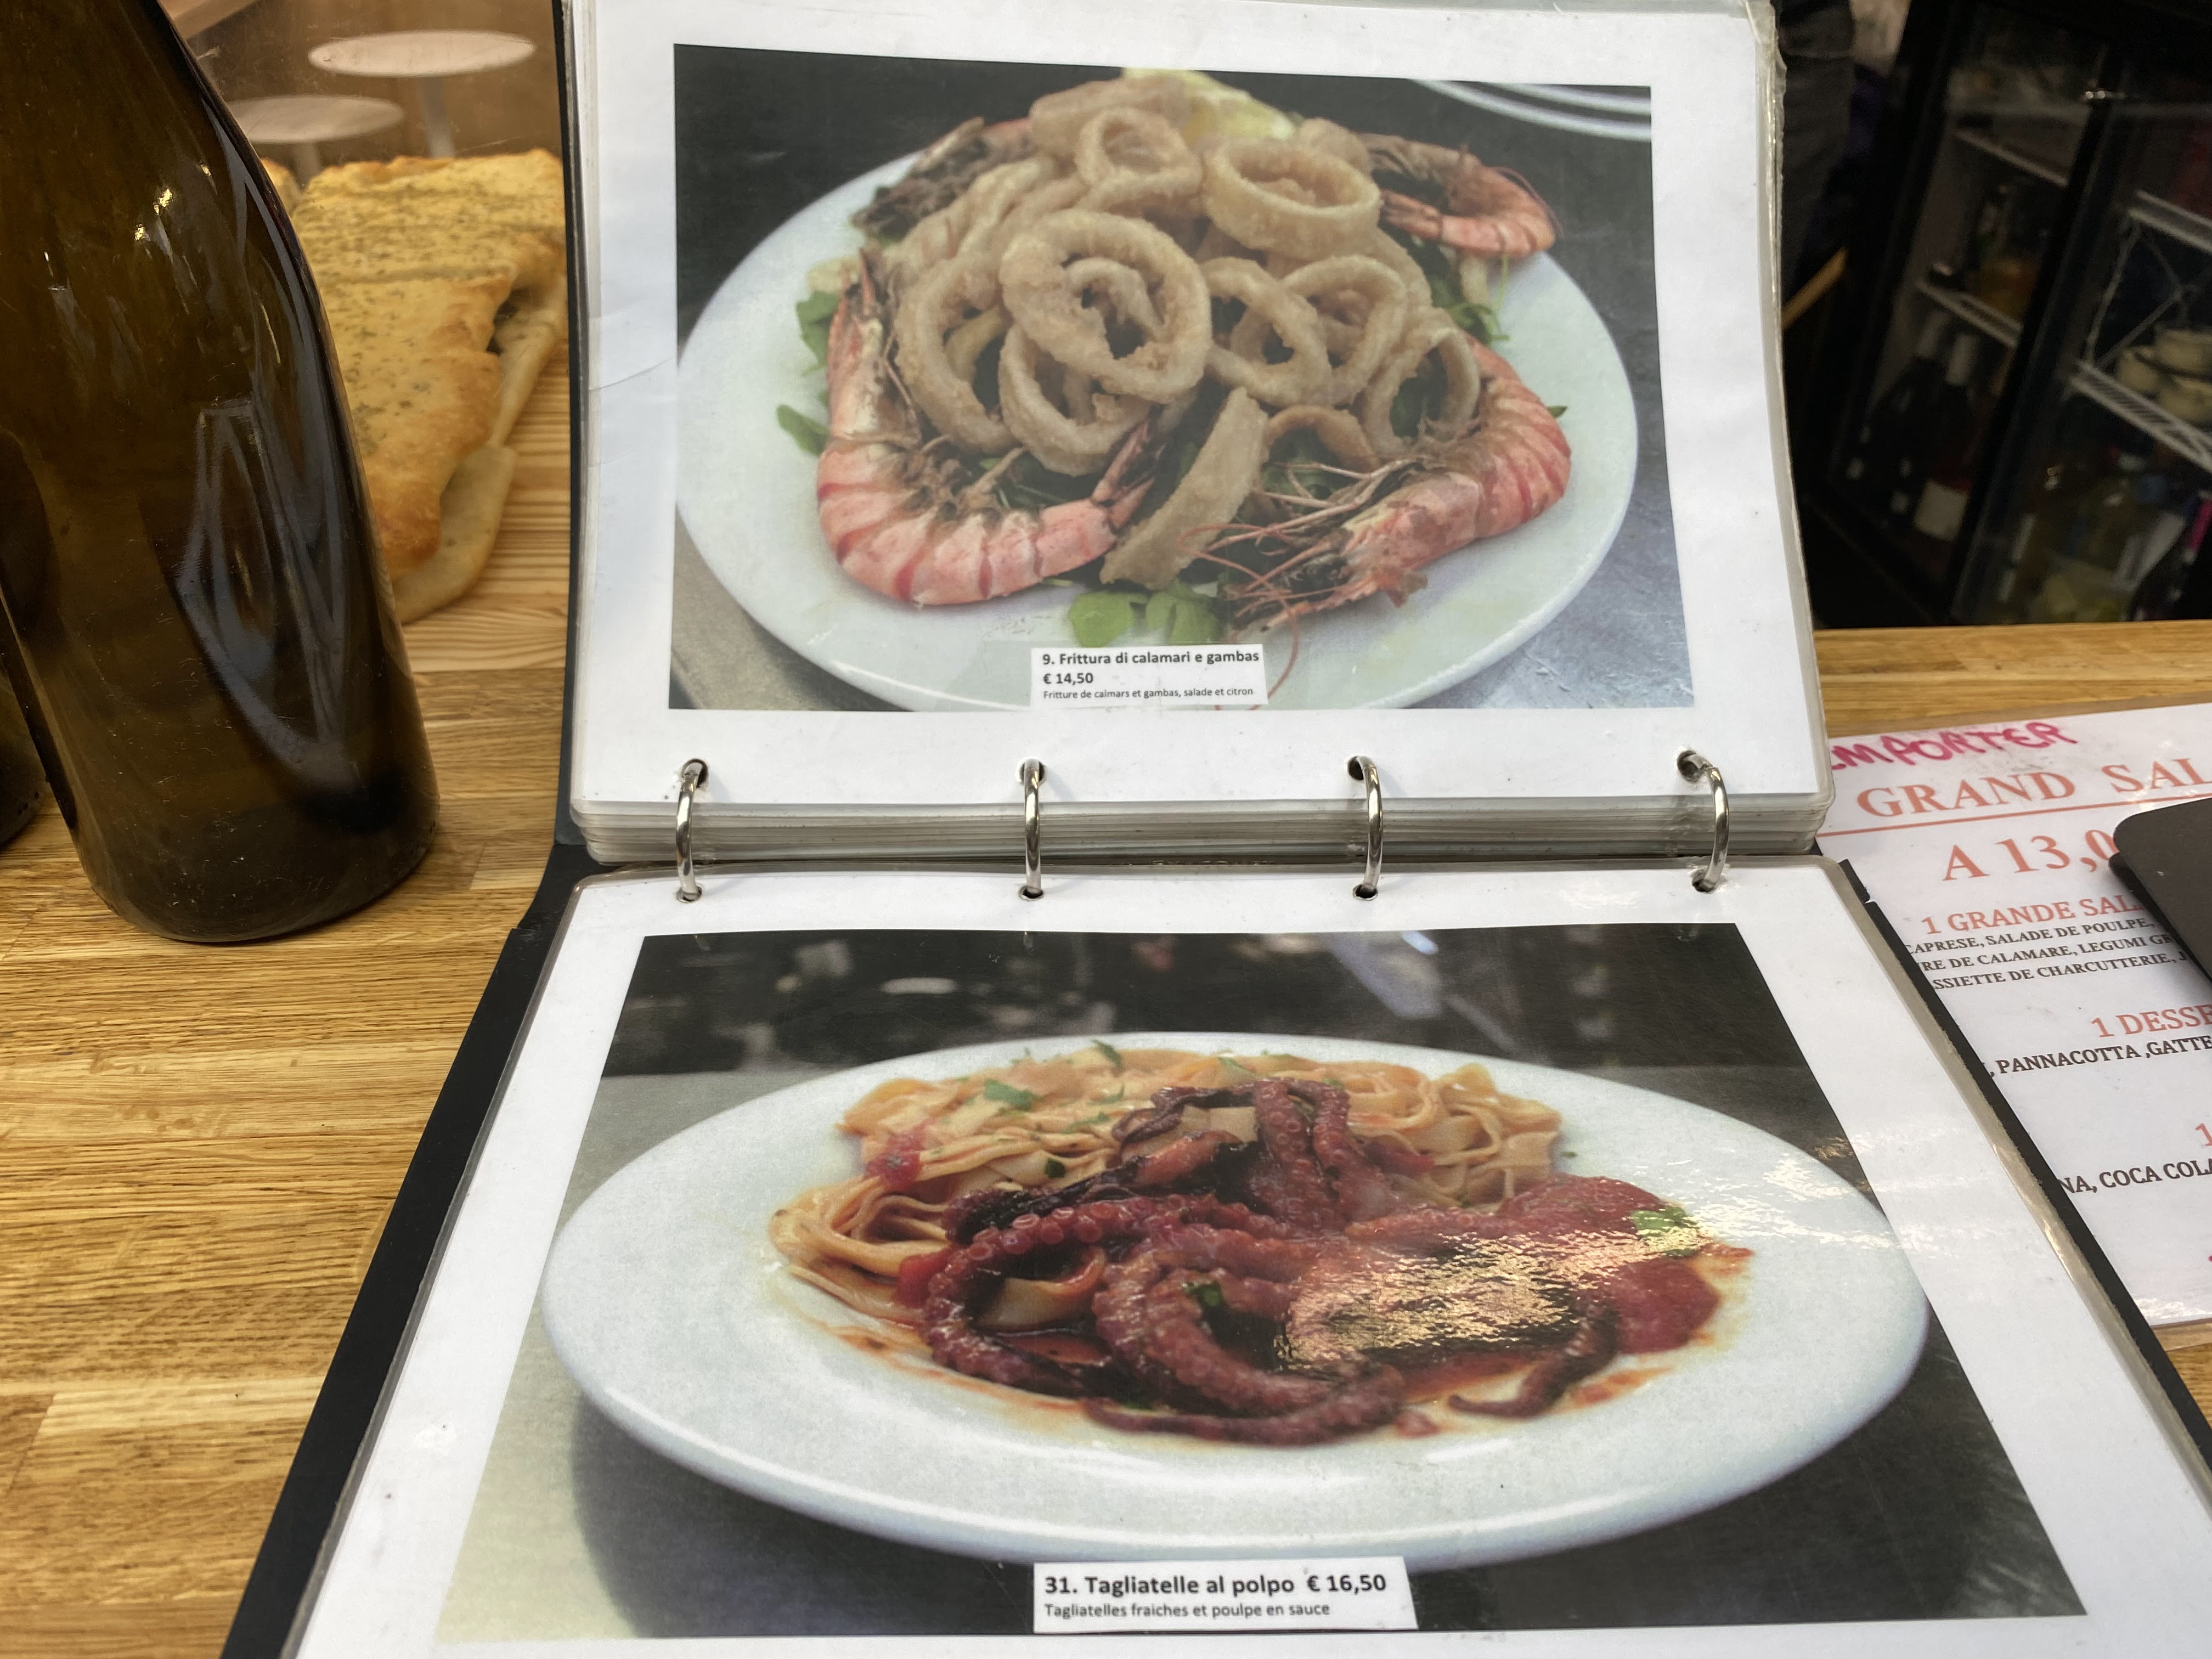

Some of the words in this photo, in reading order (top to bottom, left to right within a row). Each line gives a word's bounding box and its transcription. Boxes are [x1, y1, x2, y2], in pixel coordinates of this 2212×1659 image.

[1042, 653, 1054, 665] 9.
[1059, 653, 1111, 664] Frittura
[1115, 652, 1128, 663] di
[1132, 651, 1190, 663] calamari
[1195, 653, 1202, 662] e
[1206, 650, 1259, 664] gambas
[1043, 673, 1051, 684] €
[1056, 673, 1093, 685] 14,50
[1043, 690, 1077, 698] Fritture
[1080, 690, 1091, 698] de
[1094, 689, 1129, 698] calmars
[1144, 689, 1181, 698] gambas,
[1184, 688, 1212, 696] salade
[1832, 721, 2078, 771] MPORTER
[1857, 771, 2076, 817] GRAND
[2101, 758, 2212, 793] SAL
[1942, 844, 1990, 881] A
[1996, 829, 2120, 873] 13,0
[1922, 917, 1942, 934] 1
[1948, 901, 2075, 932] GRANDE
[1985, 929, 2053, 945] SALADE
[2054, 926, 2080, 938] DE
[2082, 918, 2154, 934] POULPE,
[1917, 960, 1946, 972] RE
[1948, 957, 1974, 968] DE
[1977, 946, 2078, 965] CALAMARE,
[2078, 936, 2147, 953] LEGUMI
[2008, 969, 2034, 981] DE
[2037, 953, 2177, 978] CHARCUTTERIE,
[2091, 1017, 2114, 1037] 1
[2116, 1005, 2212, 1035] DESSE
[1995, 1044, 2142, 1074] PANNACOTTA
[2099, 1166, 2163, 1188] COCA
[2163, 1158, 2212, 1179] COL
[1045, 1576, 1077, 1593] 31.
[1084, 1575, 1199, 1597] Tagliatelle
[1206, 1575, 1224, 1593] al
[1232, 1575, 1295, 1597] polpo
[1307, 1575, 1320, 1592] €
[1327, 1574, 1387, 1595] 16,50
[1045, 1603, 1127, 1619] Tagliatelles
[1131, 1602, 1188, 1617] fraiches
[1193, 1604, 1207, 1617] et
[1212, 1603, 1262, 1619] poulpe
[1266, 1605, 1284, 1616] en
[1289, 1604, 1330, 1615] sauce
